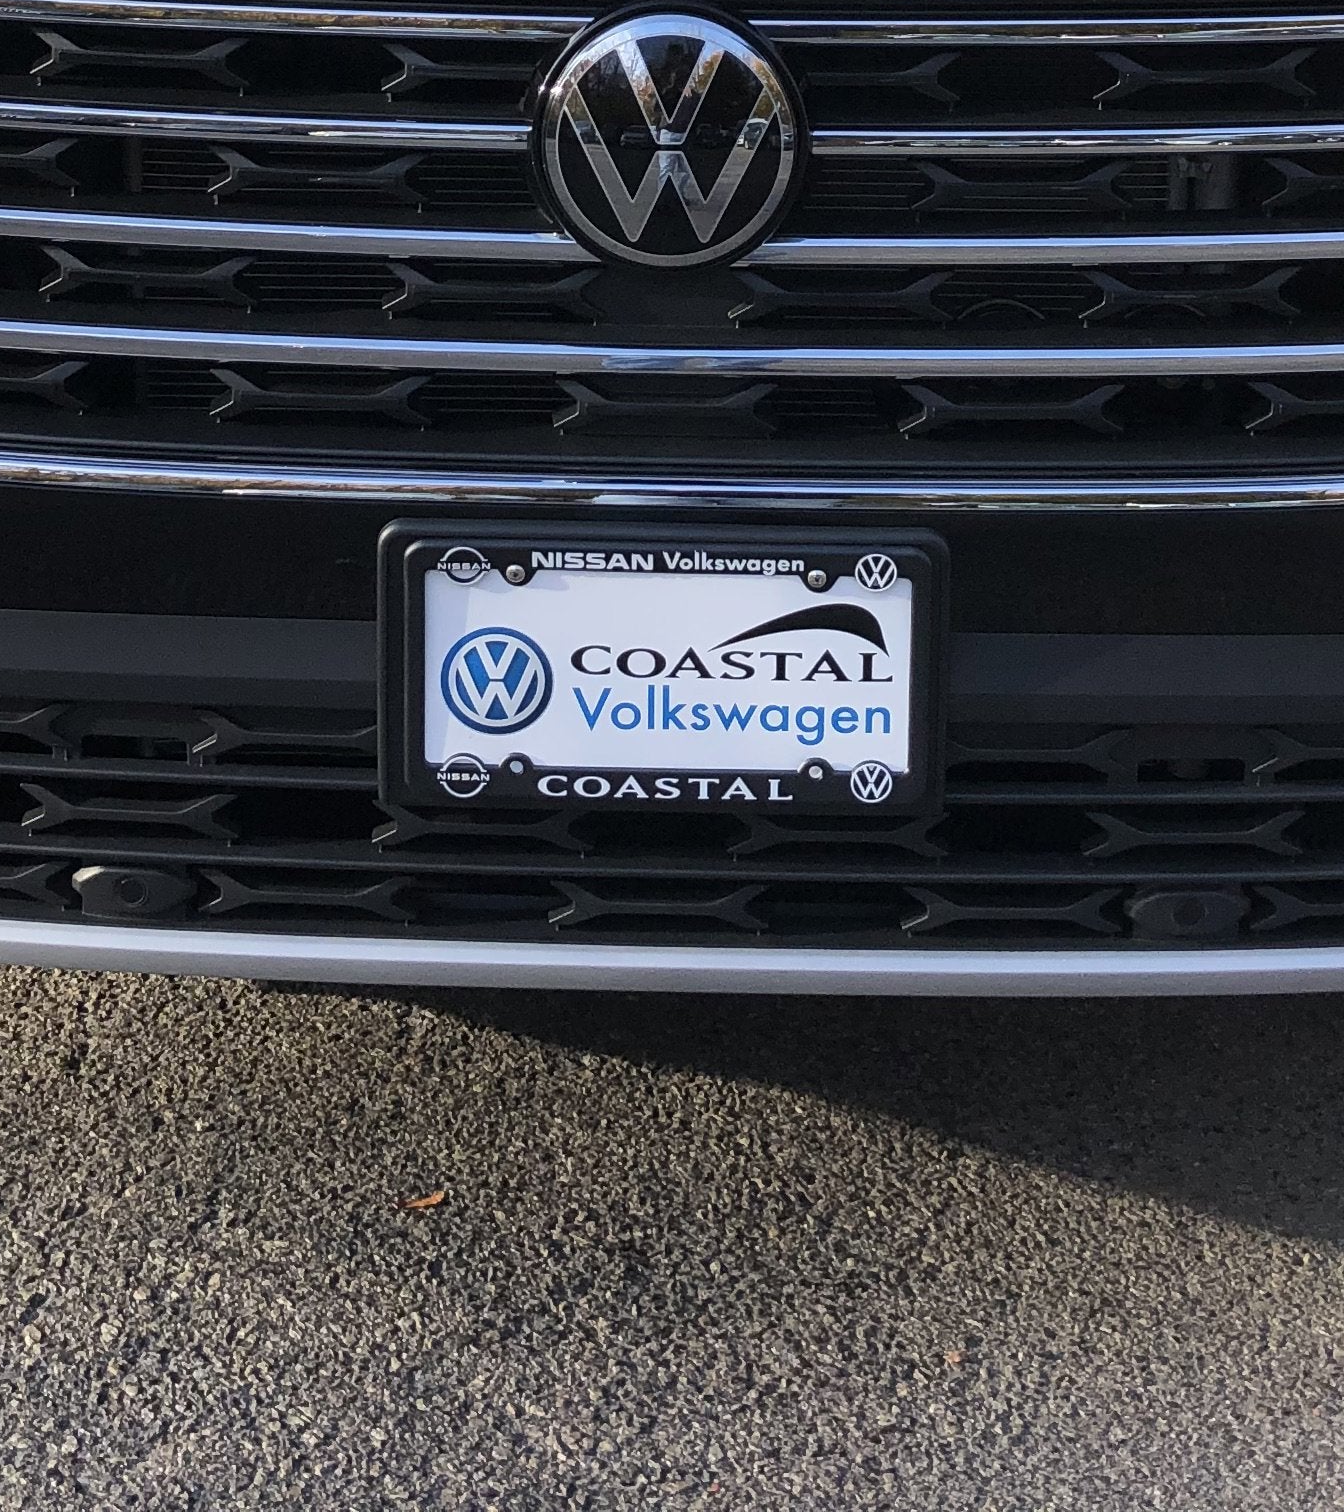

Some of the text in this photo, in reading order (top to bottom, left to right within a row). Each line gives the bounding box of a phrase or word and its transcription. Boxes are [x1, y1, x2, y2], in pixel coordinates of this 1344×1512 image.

[437, 561, 492, 571] NISSAN
[531, 550, 806, 576] NISSAN Volkswagen
[570, 644, 894, 682] COASTAL
[572, 684, 892, 746] Volkswagen
[436, 771, 491, 782] NISSAN
[537, 773, 794, 802] COASTAL
